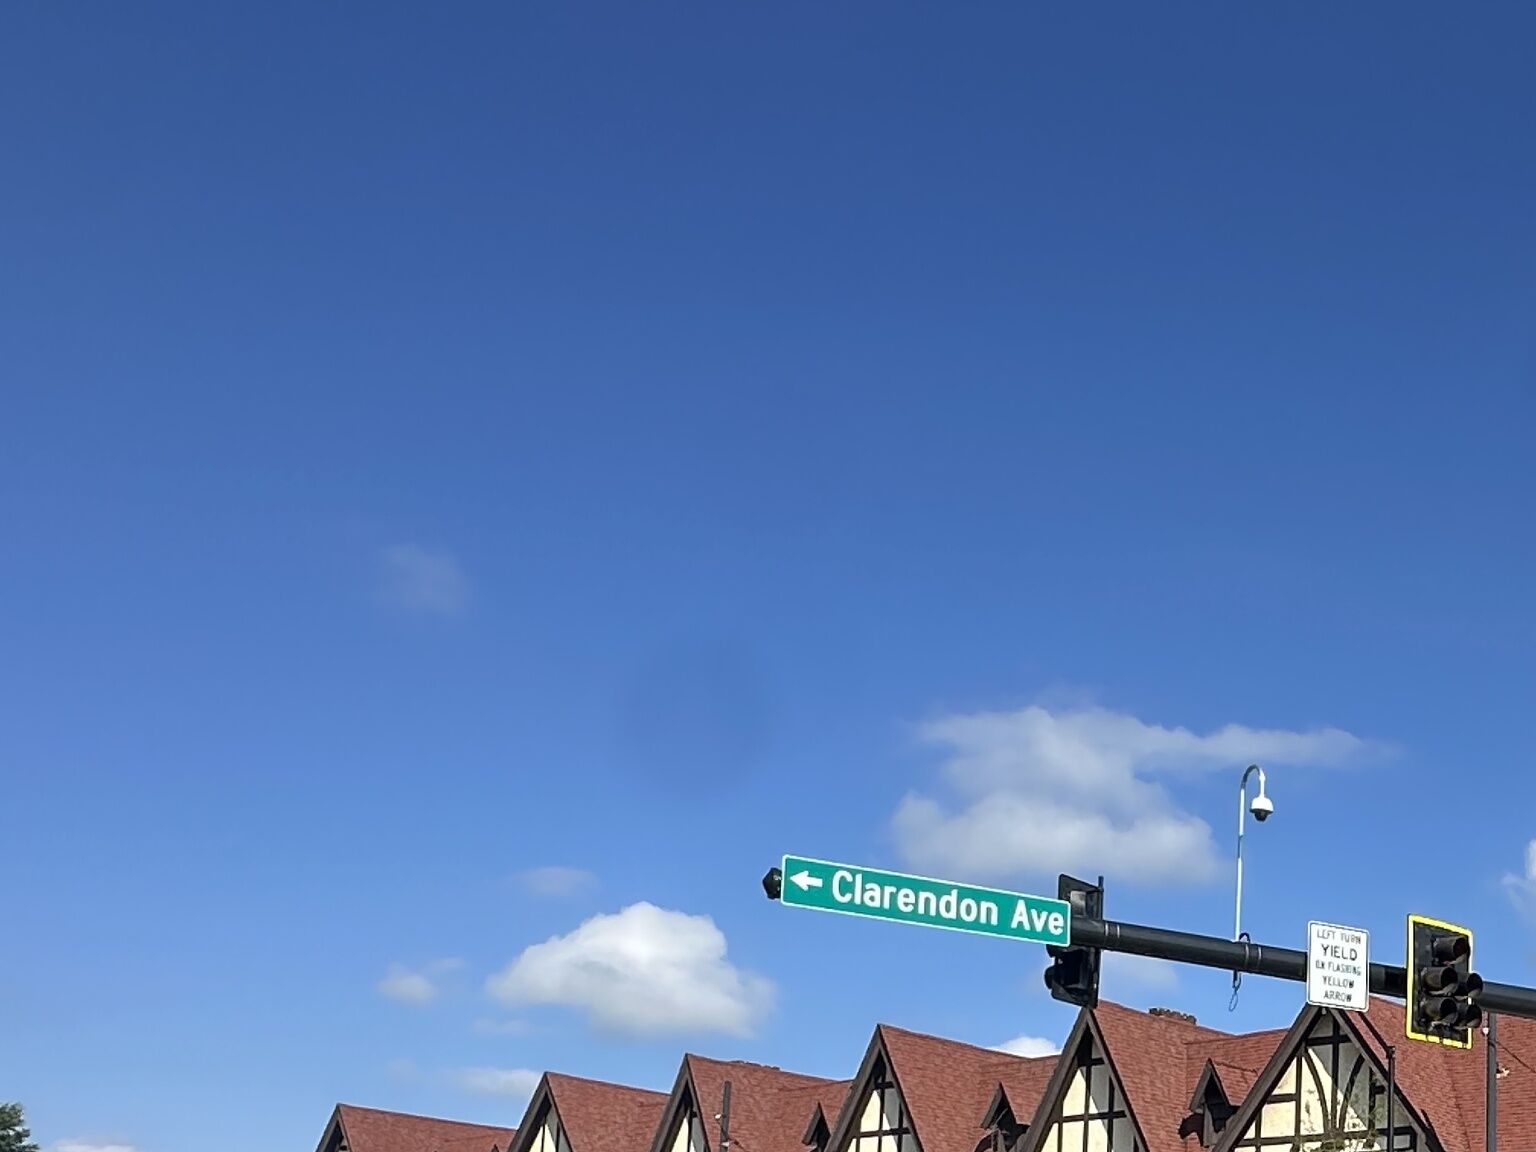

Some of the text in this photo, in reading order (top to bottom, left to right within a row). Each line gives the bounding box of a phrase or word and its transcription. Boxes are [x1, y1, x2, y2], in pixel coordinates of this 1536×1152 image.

[831, 870, 1064, 935] Clarendon Ave
[1316, 928, 1361, 944] LEFT TURN
[1321, 943, 1358, 961] YIELD
[1315, 959, 1362, 976] ON FLASHING
[1322, 975, 1355, 988] YELLOW
[1323, 990, 1352, 1002] ARROW
